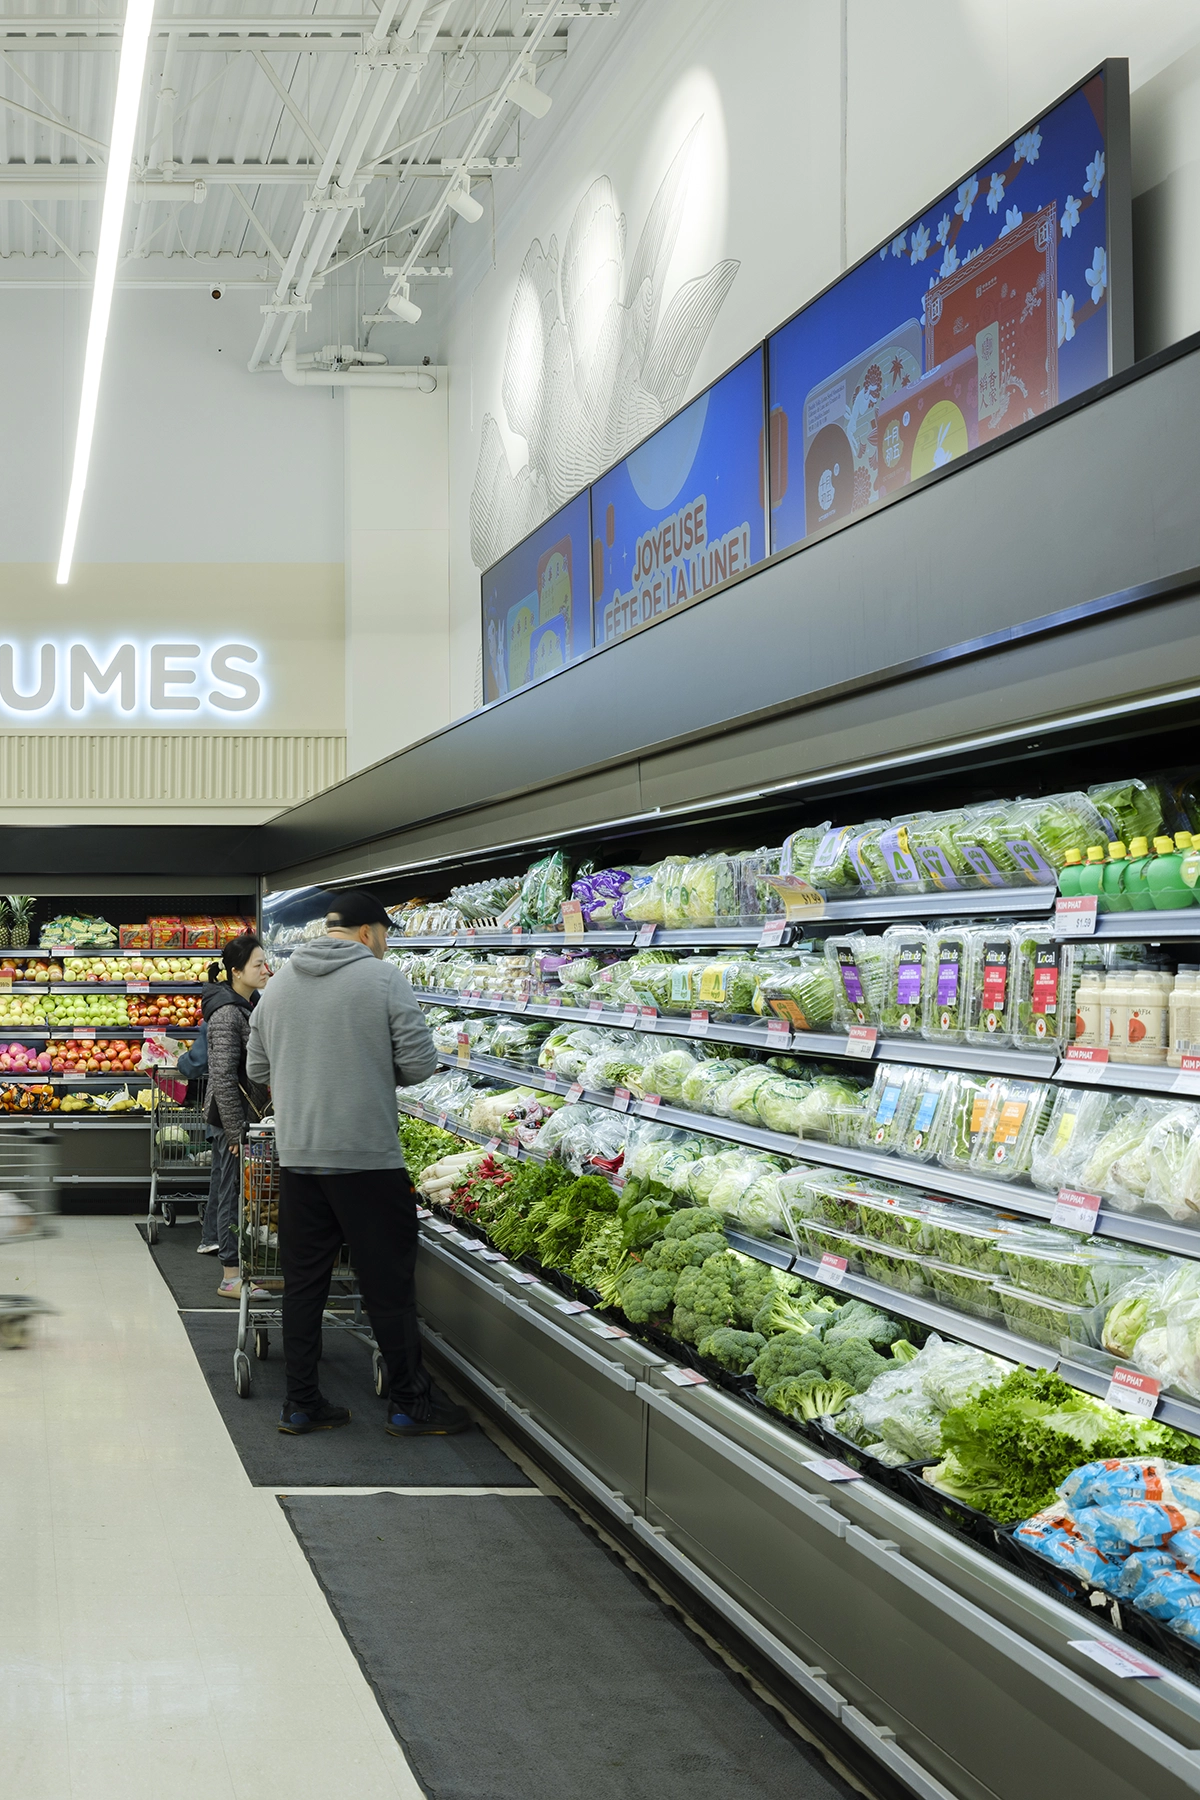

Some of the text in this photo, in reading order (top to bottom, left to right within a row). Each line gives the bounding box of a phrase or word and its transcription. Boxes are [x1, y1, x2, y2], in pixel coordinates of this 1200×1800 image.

[634, 503, 704, 582] JOYEUSE
[606, 597, 638, 641] FÊTE
[642, 582, 662, 622] DE
[666, 568, 688, 610] LA
[1067, 900, 1082, 908] PHAT
[1037, 951, 1055, 963] Local
[1068, 1049, 1094, 1060] KIM PHAT
[1183, 1059, 1194, 1069] KIM
[1059, 1193, 1085, 1204] KIM PHAT
[1114, 1371, 1144, 1387] KIM PHAT
[1137, 1396, 1153, 1407] $1.79
